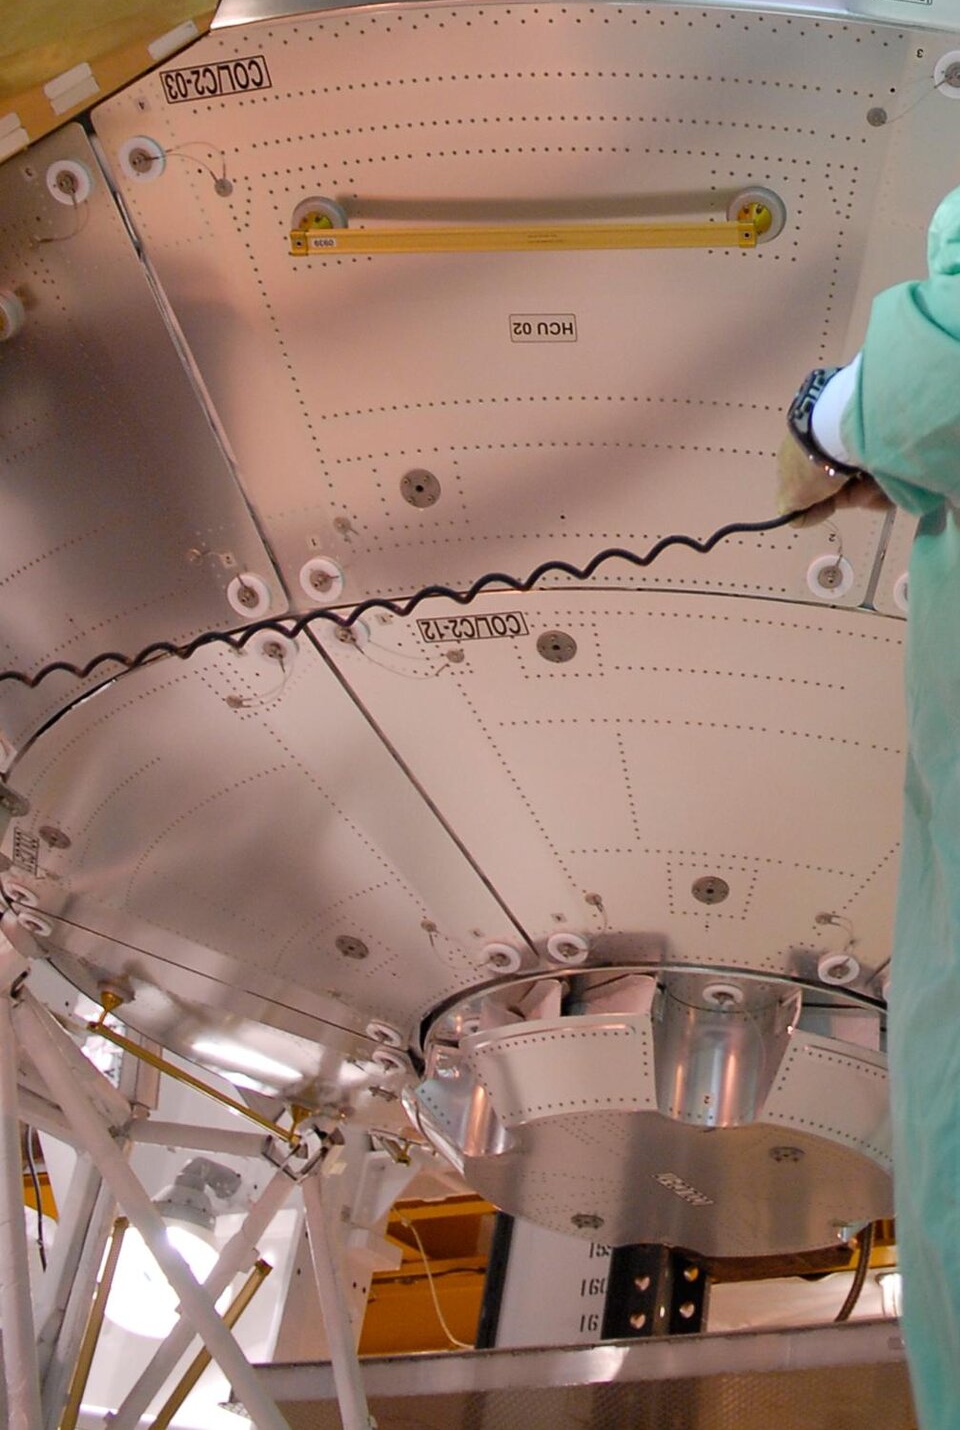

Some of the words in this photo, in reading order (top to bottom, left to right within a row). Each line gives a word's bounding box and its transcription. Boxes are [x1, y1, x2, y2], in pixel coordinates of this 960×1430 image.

[164, 59, 264, 101] COL/C2-03
[512, 322, 532, 335] 02
[537, 322, 574, 335] HCU
[420, 614, 522, 641] COL/C2-12
